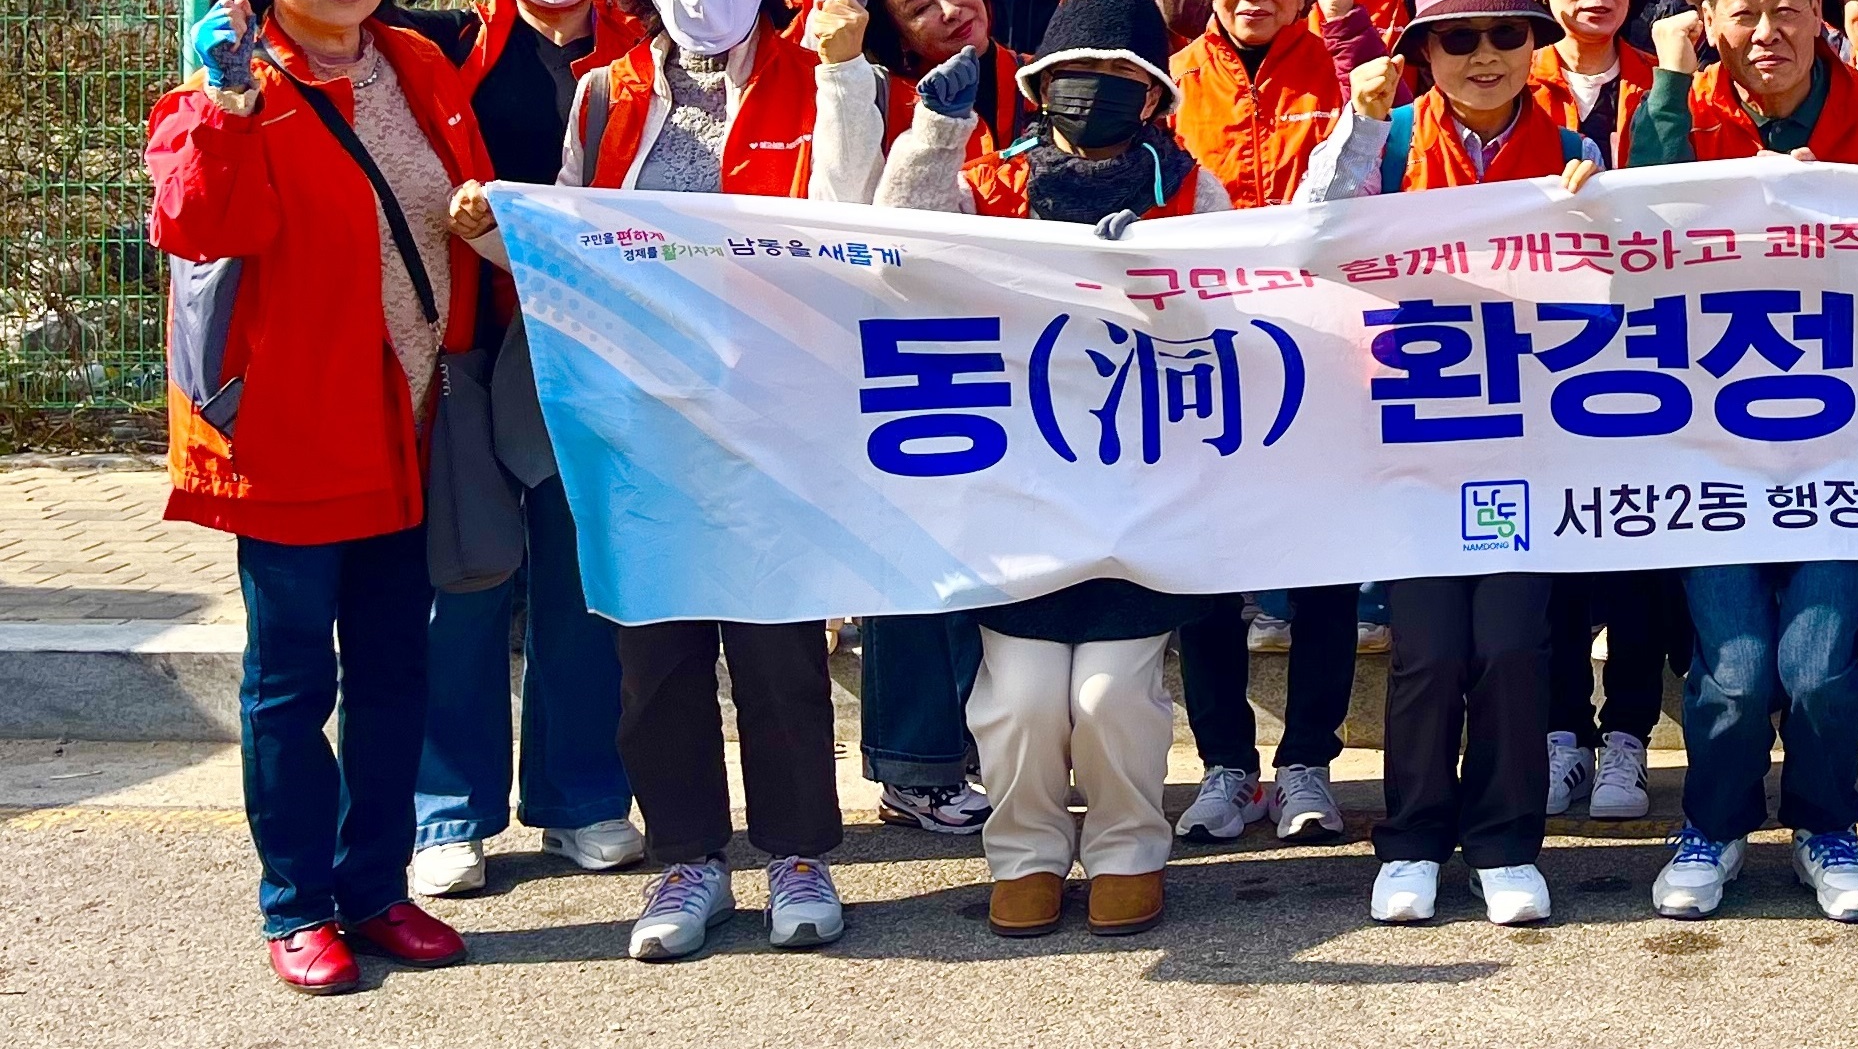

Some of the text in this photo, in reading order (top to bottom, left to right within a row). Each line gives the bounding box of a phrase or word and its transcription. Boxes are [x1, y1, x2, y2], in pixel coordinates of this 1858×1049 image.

[580, 228, 666, 247] 구민을 편하게
[623, 246, 658, 262] 경제를
[727, 238, 901, 267] 남동을 새롭게
[1126, 267, 1320, 311] 구민과
[1337, 241, 1470, 284] 함께
[1488, 228, 1742, 275] 깨끗하고
[858, 313, 1306, 477] 동(洞)
[1553, 482, 1748, 539] 서창2동
[1463, 541, 1510, 551] NAMDONG
